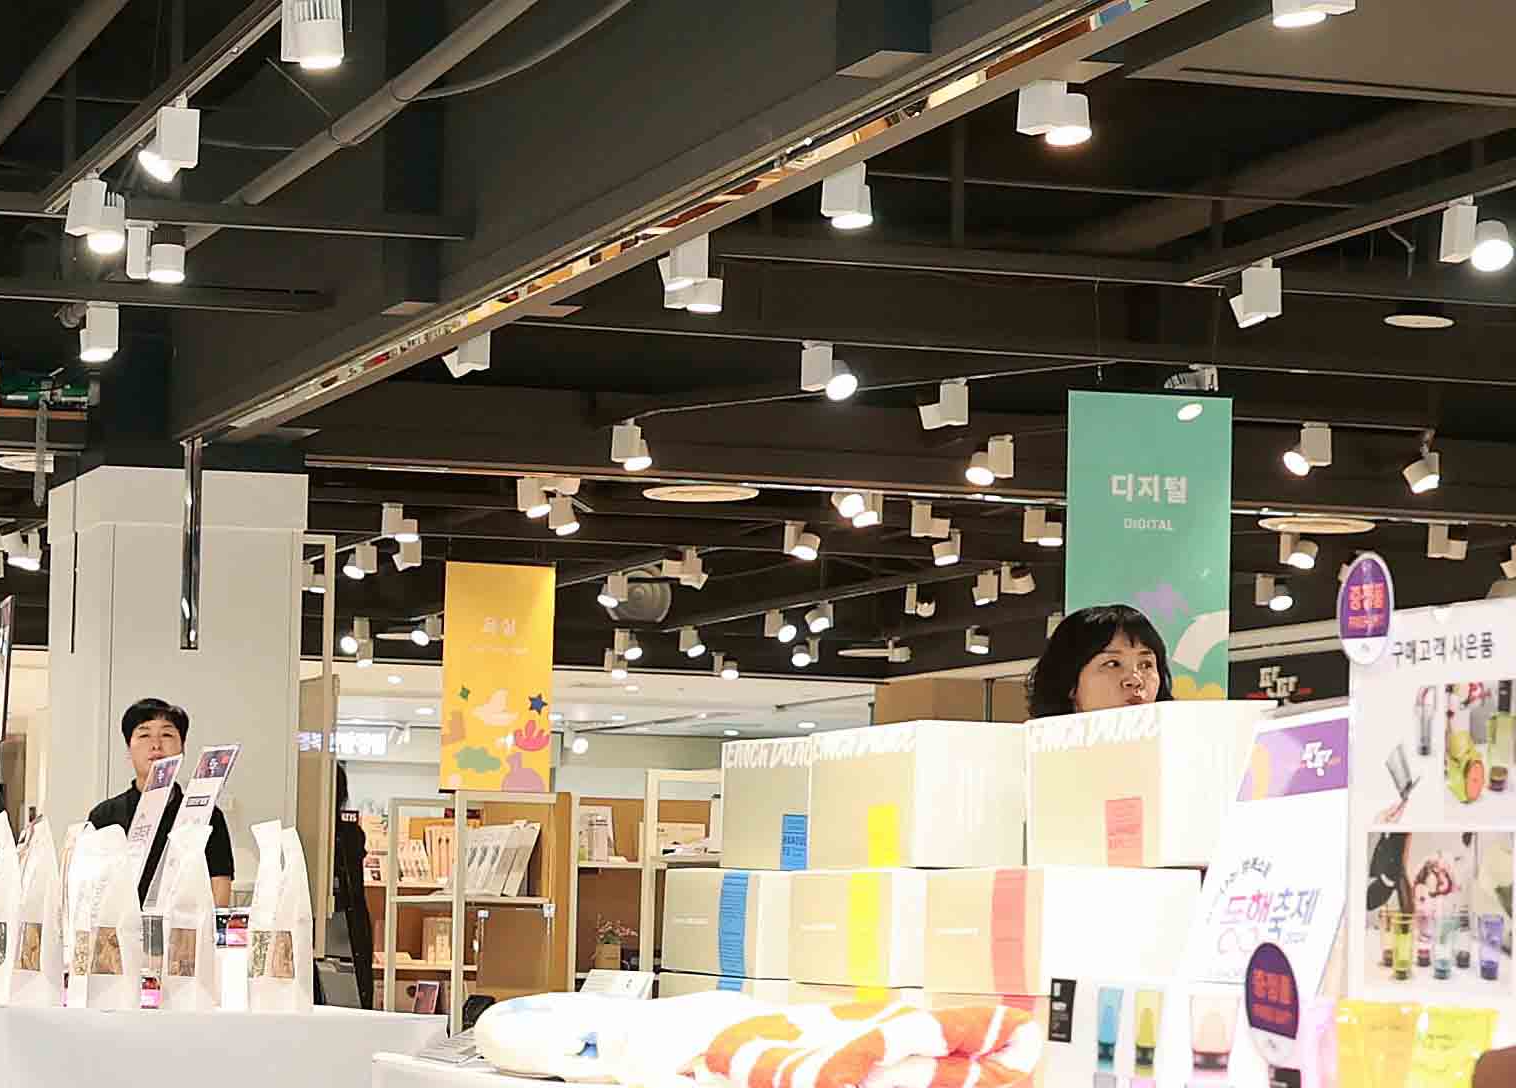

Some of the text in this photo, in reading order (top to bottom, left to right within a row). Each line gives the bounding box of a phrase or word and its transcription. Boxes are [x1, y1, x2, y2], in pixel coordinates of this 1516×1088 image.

[1111, 474, 1188, 504] 디지털
[1124, 518, 1173, 531] DIGITAL
[1392, 631, 1493, 667] 구매고객 사은품
